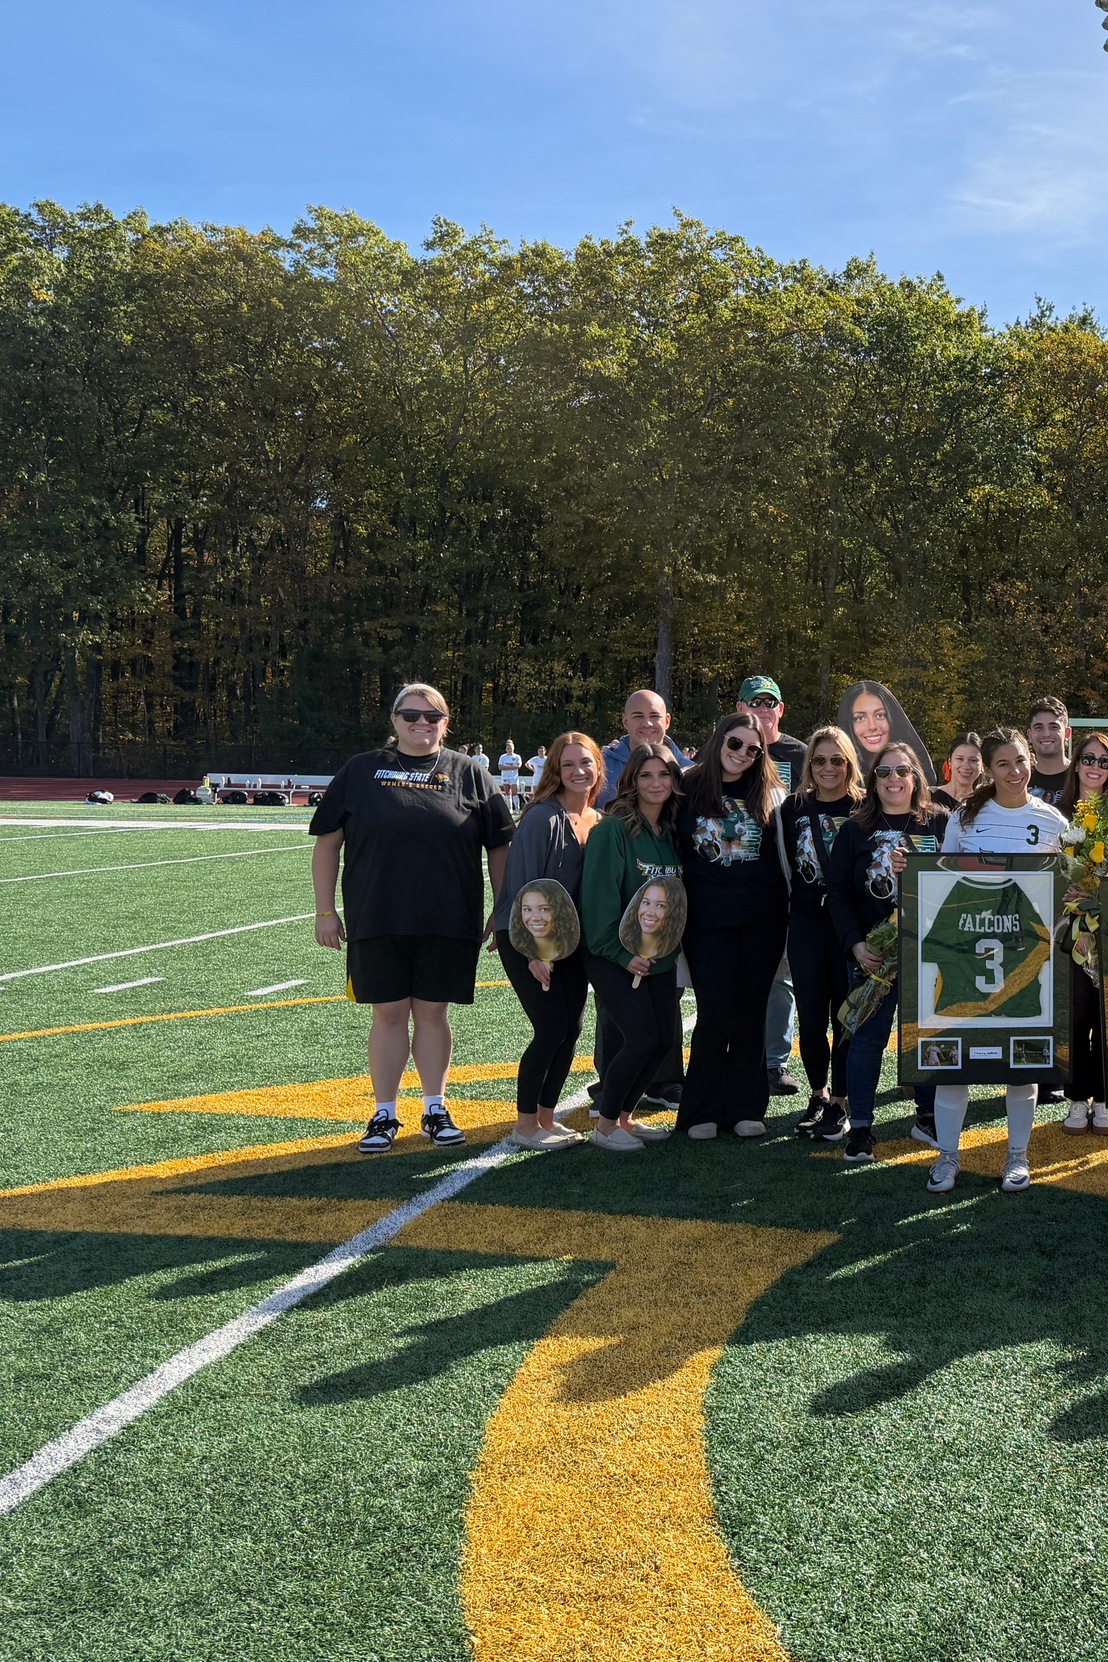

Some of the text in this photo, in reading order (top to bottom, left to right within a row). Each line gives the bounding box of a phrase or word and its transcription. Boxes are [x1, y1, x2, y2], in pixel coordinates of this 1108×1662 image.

[373, 769, 430, 782] FITCHBURG STATE
[1026, 824, 1040, 846] 3
[958, 913, 1020, 933] FALCONS
[975, 938, 1005, 993] 3
